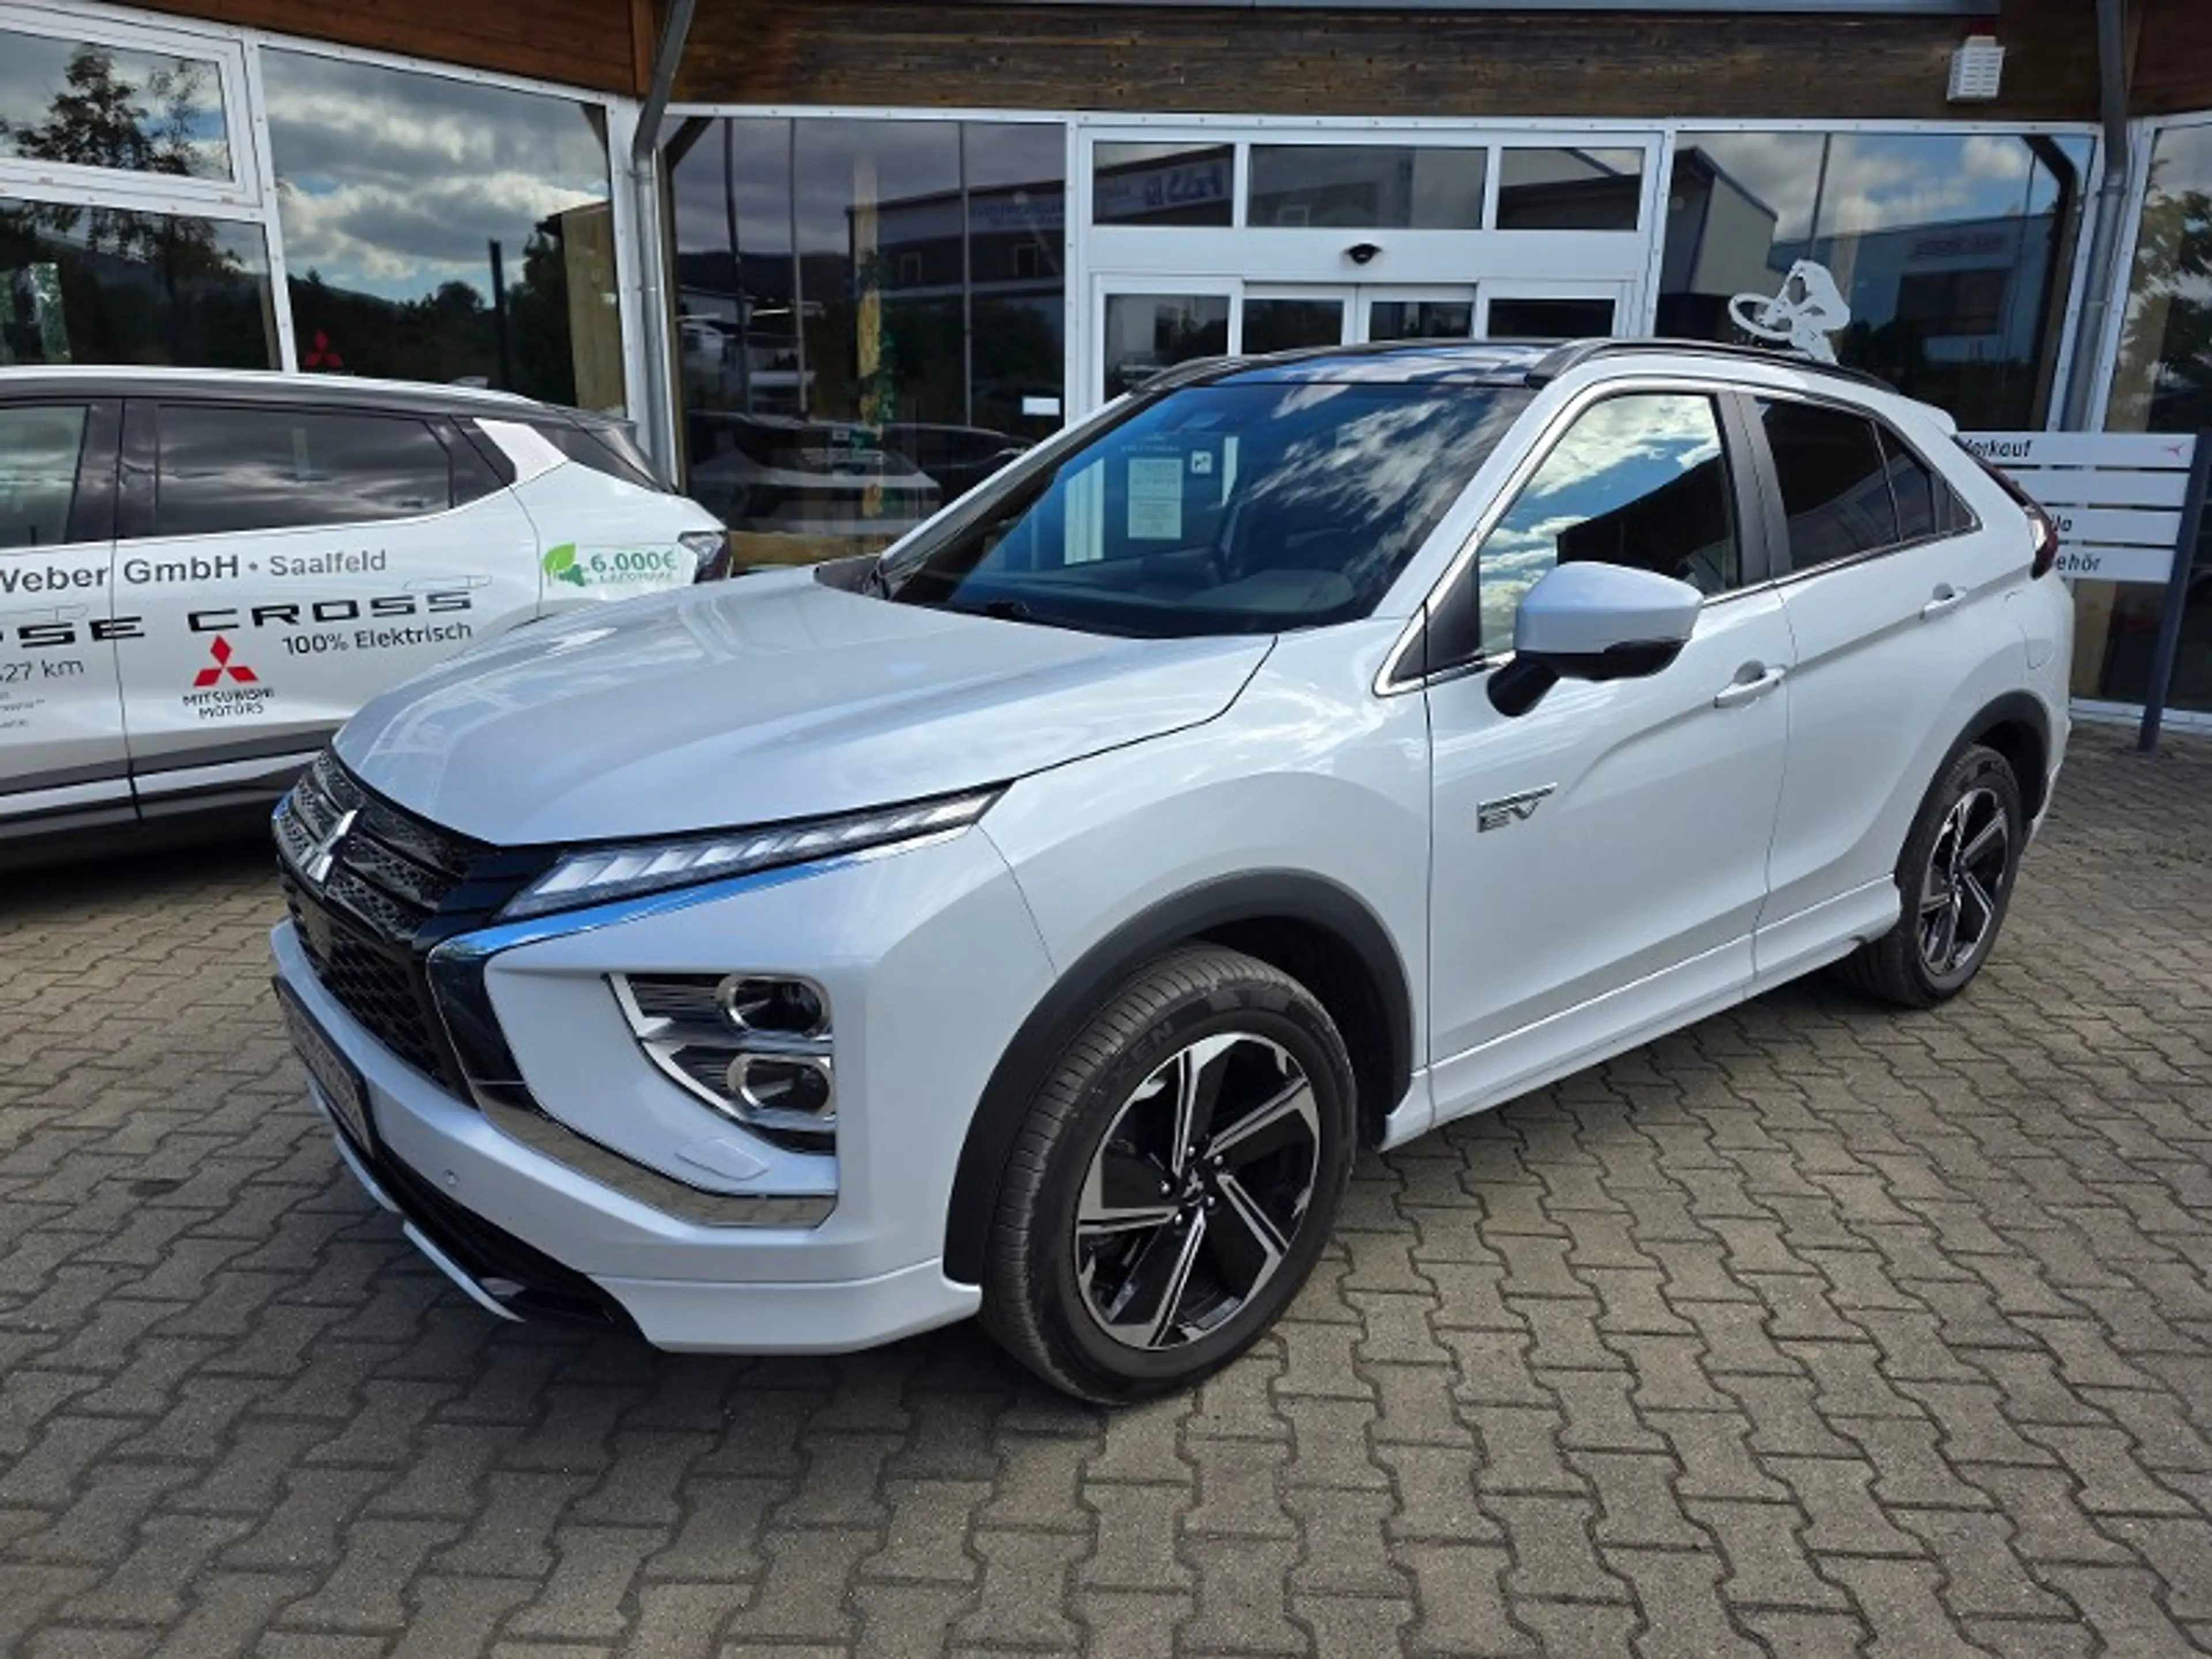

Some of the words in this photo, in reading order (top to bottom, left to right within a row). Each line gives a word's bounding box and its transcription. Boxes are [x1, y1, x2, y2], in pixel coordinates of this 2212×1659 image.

[123, 554, 239, 585] GmbH
[269, 549, 387, 577] Saalfeld
[2056, 553, 2101, 571] ehör
[0, 616, 145, 648] SE
[187, 591, 471, 632] CROSS
[282, 633, 350, 656] 100%
[354, 622, 472, 649] Elektrisch
[0, 661, 32, 683] 27
[41, 658, 84, 678] km
